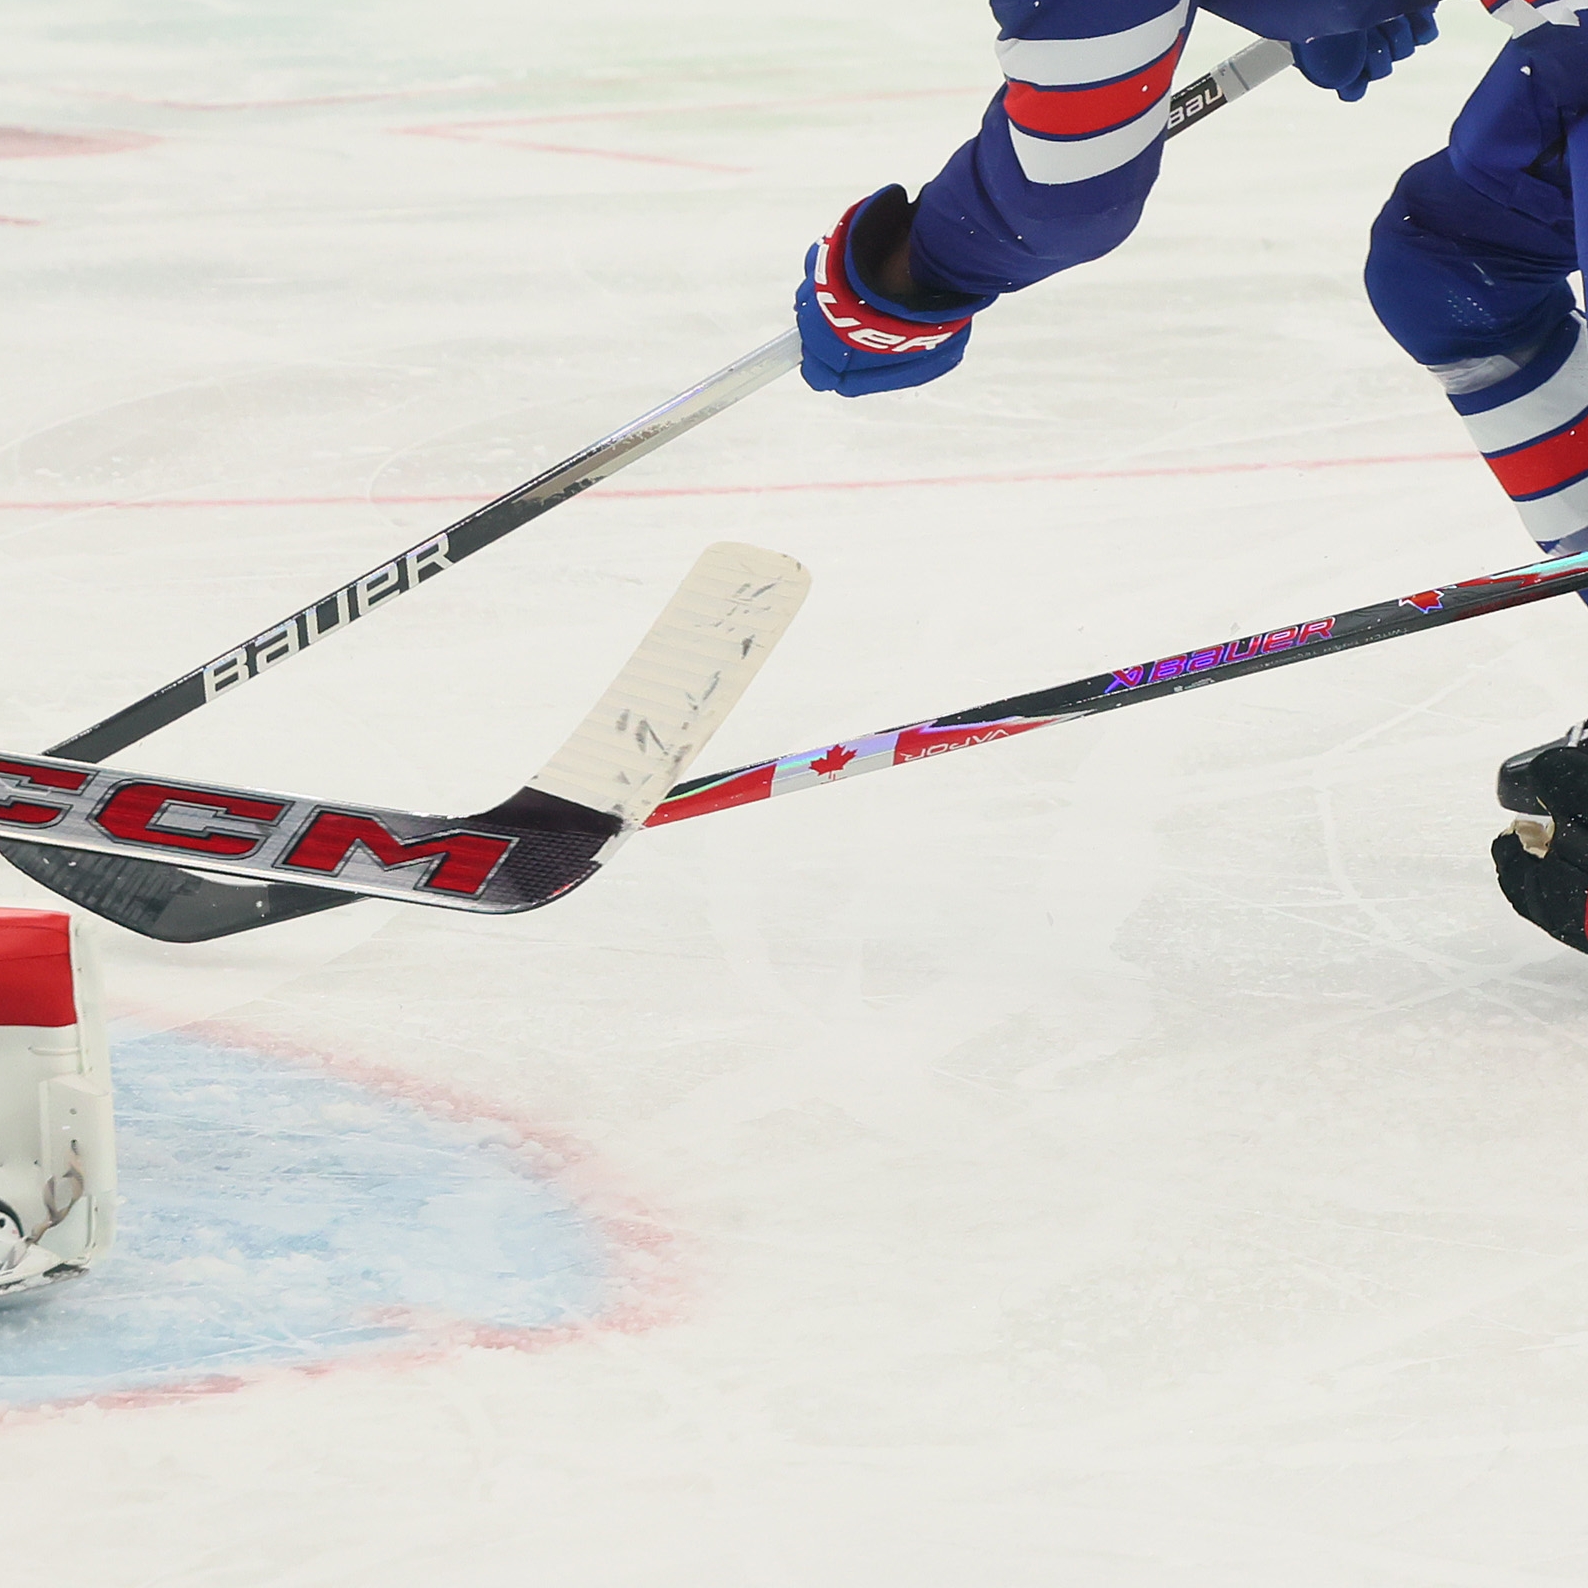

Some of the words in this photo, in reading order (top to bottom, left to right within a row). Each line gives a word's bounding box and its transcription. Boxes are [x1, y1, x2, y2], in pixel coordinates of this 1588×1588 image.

[1166, 84, 1225, 131] BAU
[202, 531, 455, 704] BAUER
[1147, 615, 1337, 685] BAUER
